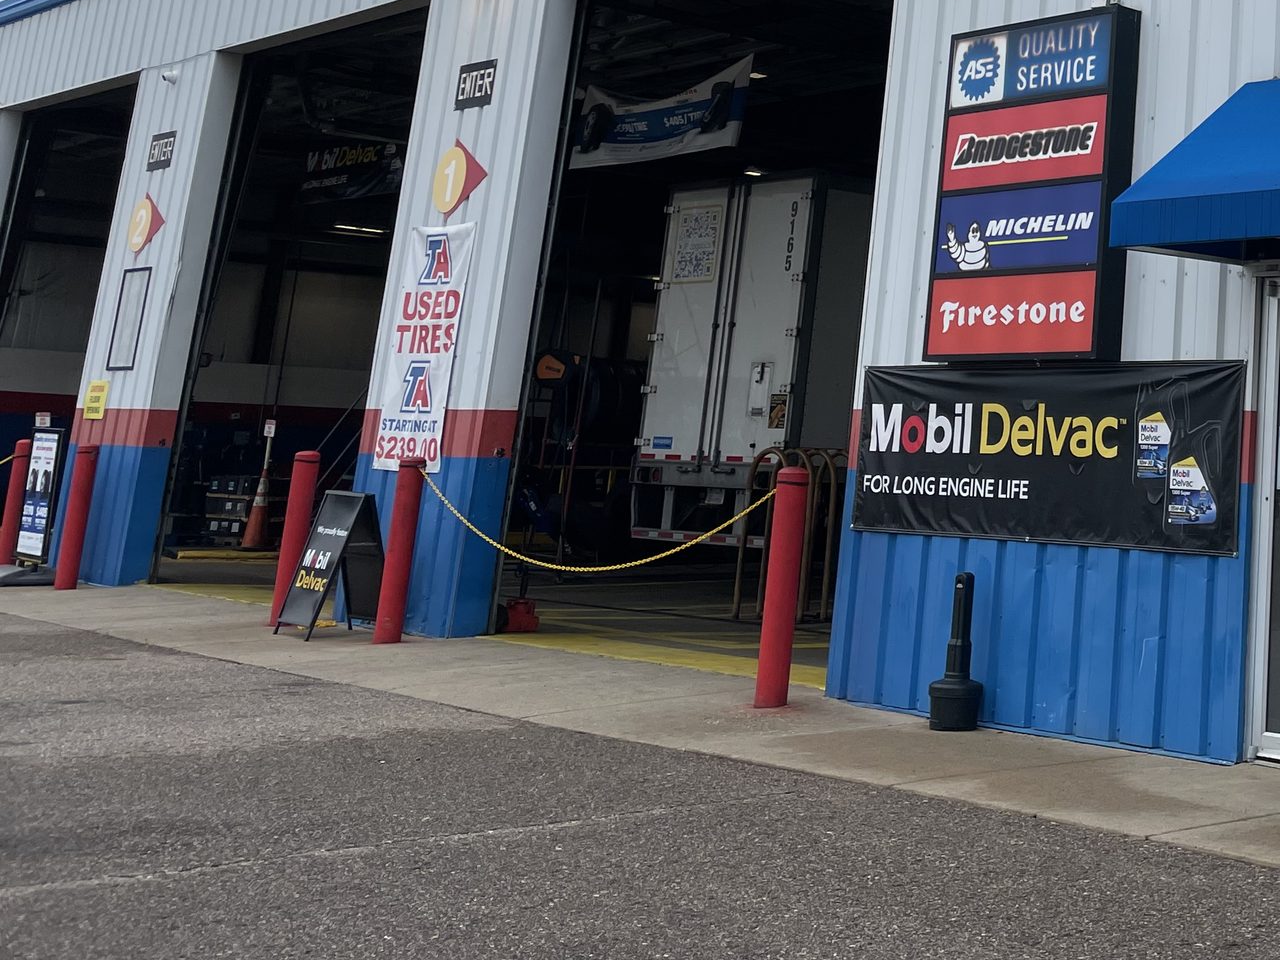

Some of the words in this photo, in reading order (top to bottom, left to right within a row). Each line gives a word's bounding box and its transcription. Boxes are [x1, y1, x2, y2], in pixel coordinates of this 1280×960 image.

[1019, 21, 1100, 59] QUALITY
[457, 68, 495, 101] ENTER
[962, 57, 995, 82] ASE
[1016, 55, 1097, 91] SERVICE
[149, 137, 174, 163] ENTER
[952, 123, 1096, 168] BRIDGESTONE
[444, 159, 456, 202] 1
[132, 208, 147, 243] 2
[784, 200, 798, 271] 9165
[984, 211, 1094, 237] MICHELIN
[418, 233, 453, 285] TA
[402, 290, 461, 321] USED
[939, 300, 1086, 333] Firestone
[396, 323, 455, 354] TIRES
[400, 360, 432, 414] TA
[868, 402, 974, 454] Mobil
[1140, 424, 1158, 433] Mobil
[1140, 433, 1161, 442] Delvac
[862, 474, 890, 494] FOR
[893, 476, 935, 496] LONG
[938, 477, 995, 498] ENGINE
[998, 479, 1029, 499] LIFE
[1171, 478, 1193, 487] Delvac
[1172, 469, 1190, 478] Mobil
[302, 548, 332, 570] Mobil
[295, 569, 328, 592] Delvac
